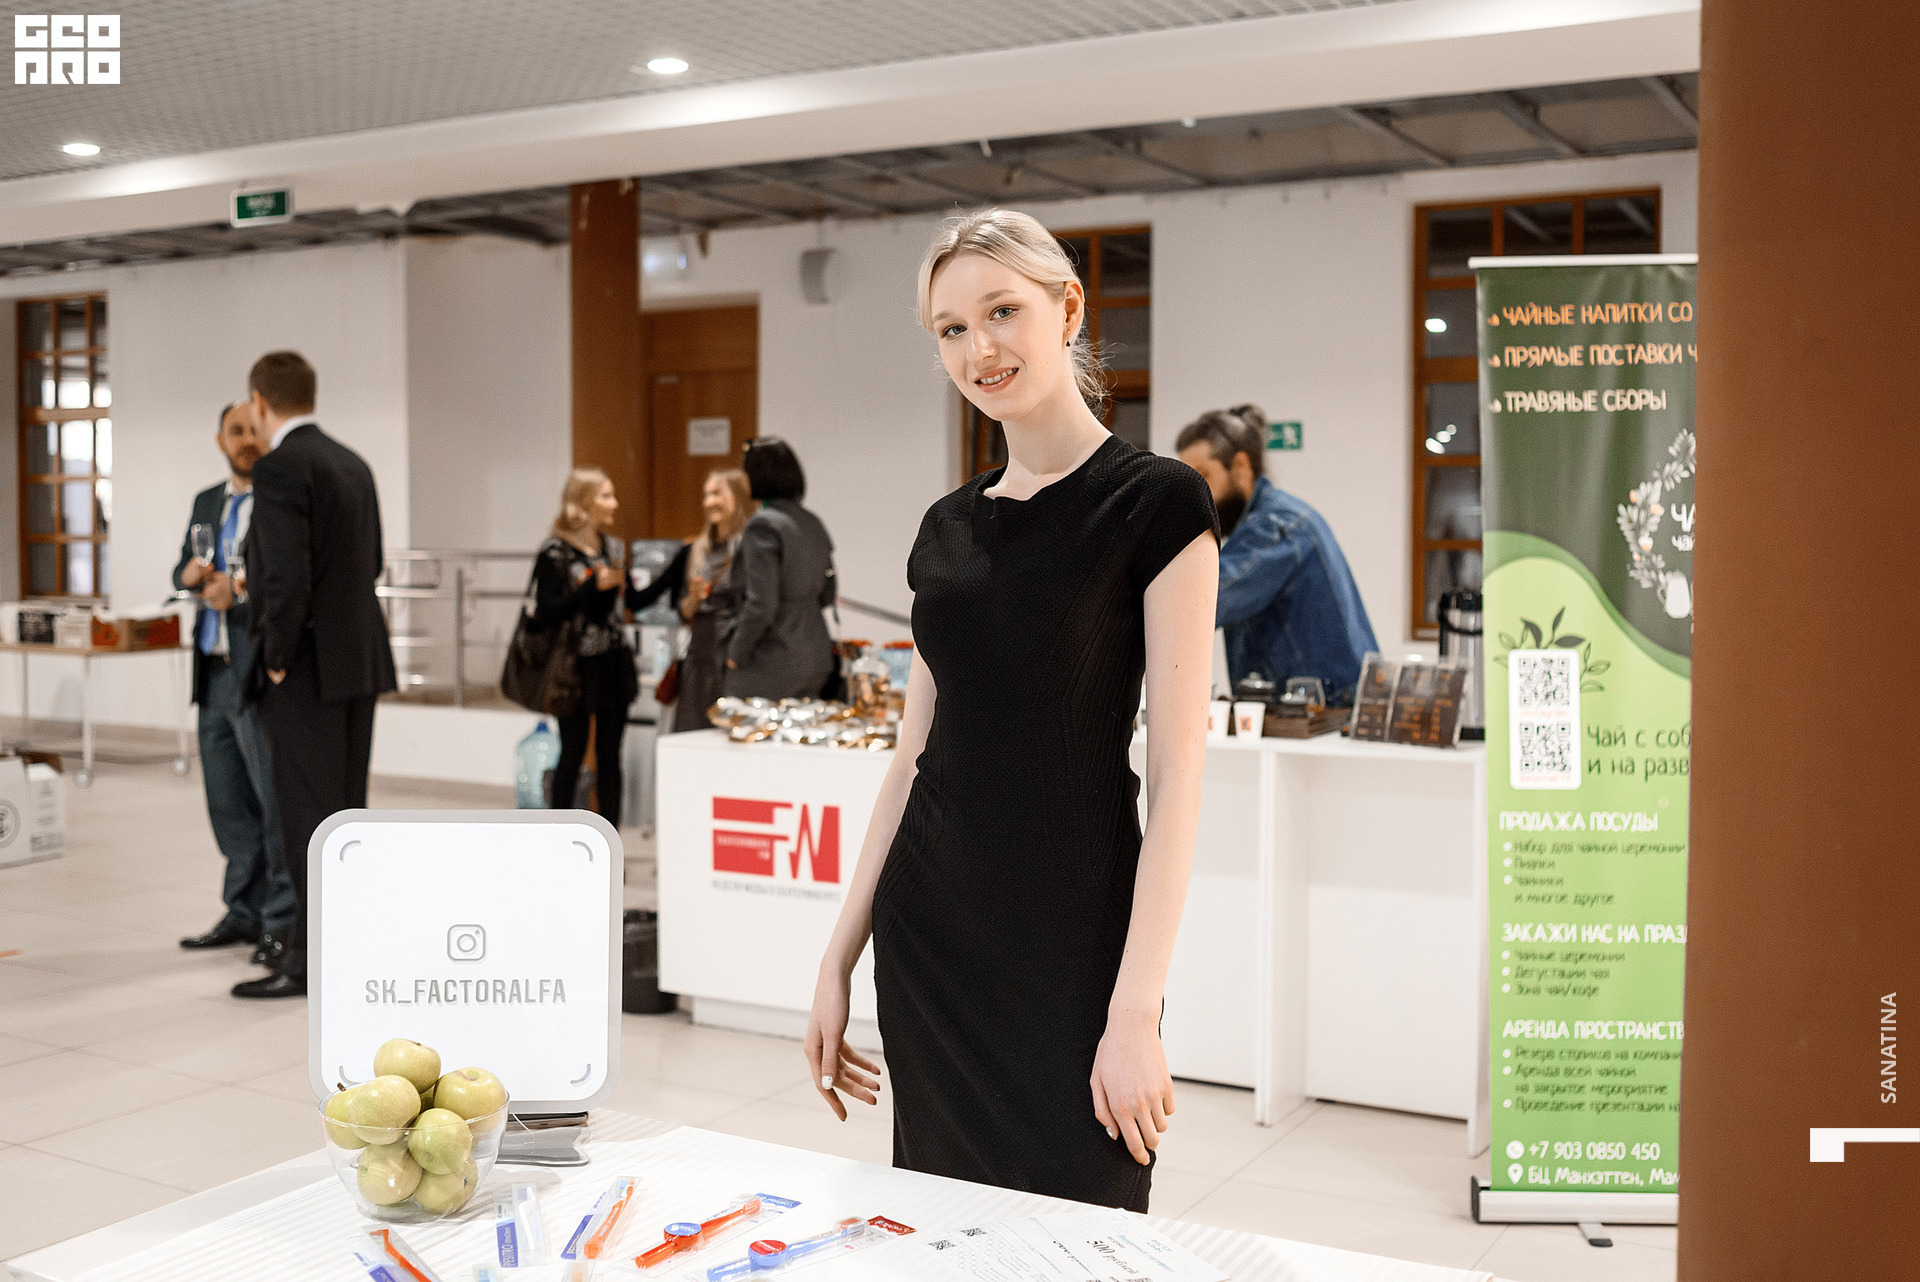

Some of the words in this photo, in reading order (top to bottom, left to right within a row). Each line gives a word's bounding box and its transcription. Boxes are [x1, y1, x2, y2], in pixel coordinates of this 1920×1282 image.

[1503, 302, 1575, 326] ЧАЙНЫЕ
[1581, 303, 1662, 324] НАПИТКИ
[1668, 302, 1693, 322] СО
[1505, 346, 1584, 367] ПРЯМЫЕ
[1590, 344, 1682, 366] ПОСТАВКИ
[1503, 389, 1598, 413] ТРАВЯНЫЕ
[1602, 388, 1666, 412] СБОРЫ
[1587, 724, 1626, 748] Чай
[1636, 729, 1647, 748] с
[1588, 759, 1600, 775] и
[1611, 759, 1635, 775] на
[1500, 811, 1586, 832] ПРОДАЖА
[1590, 812, 1658, 833] ПОСУДЫ
[1502, 922, 1577, 943] ЗАКАЖИ
[1581, 923, 1613, 944] НАС
[1618, 924, 1640, 943] НА
[365, 978, 567, 1005] SK_FACTORALFA
[1502, 1019, 1570, 1040] АРЕНДА
[1574, 1020, 1684, 1040] ПРОСТРАНСТВ
[1529, 1141, 1550, 1159] +7
[1553, 1141, 1583, 1160] 903
[1586, 1141, 1627, 1161] 0850
[1630, 1142, 1661, 1161] 450
[1528, 1165, 1551, 1186] БЦ
[1555, 1166, 1644, 1187] Манхэттен,
